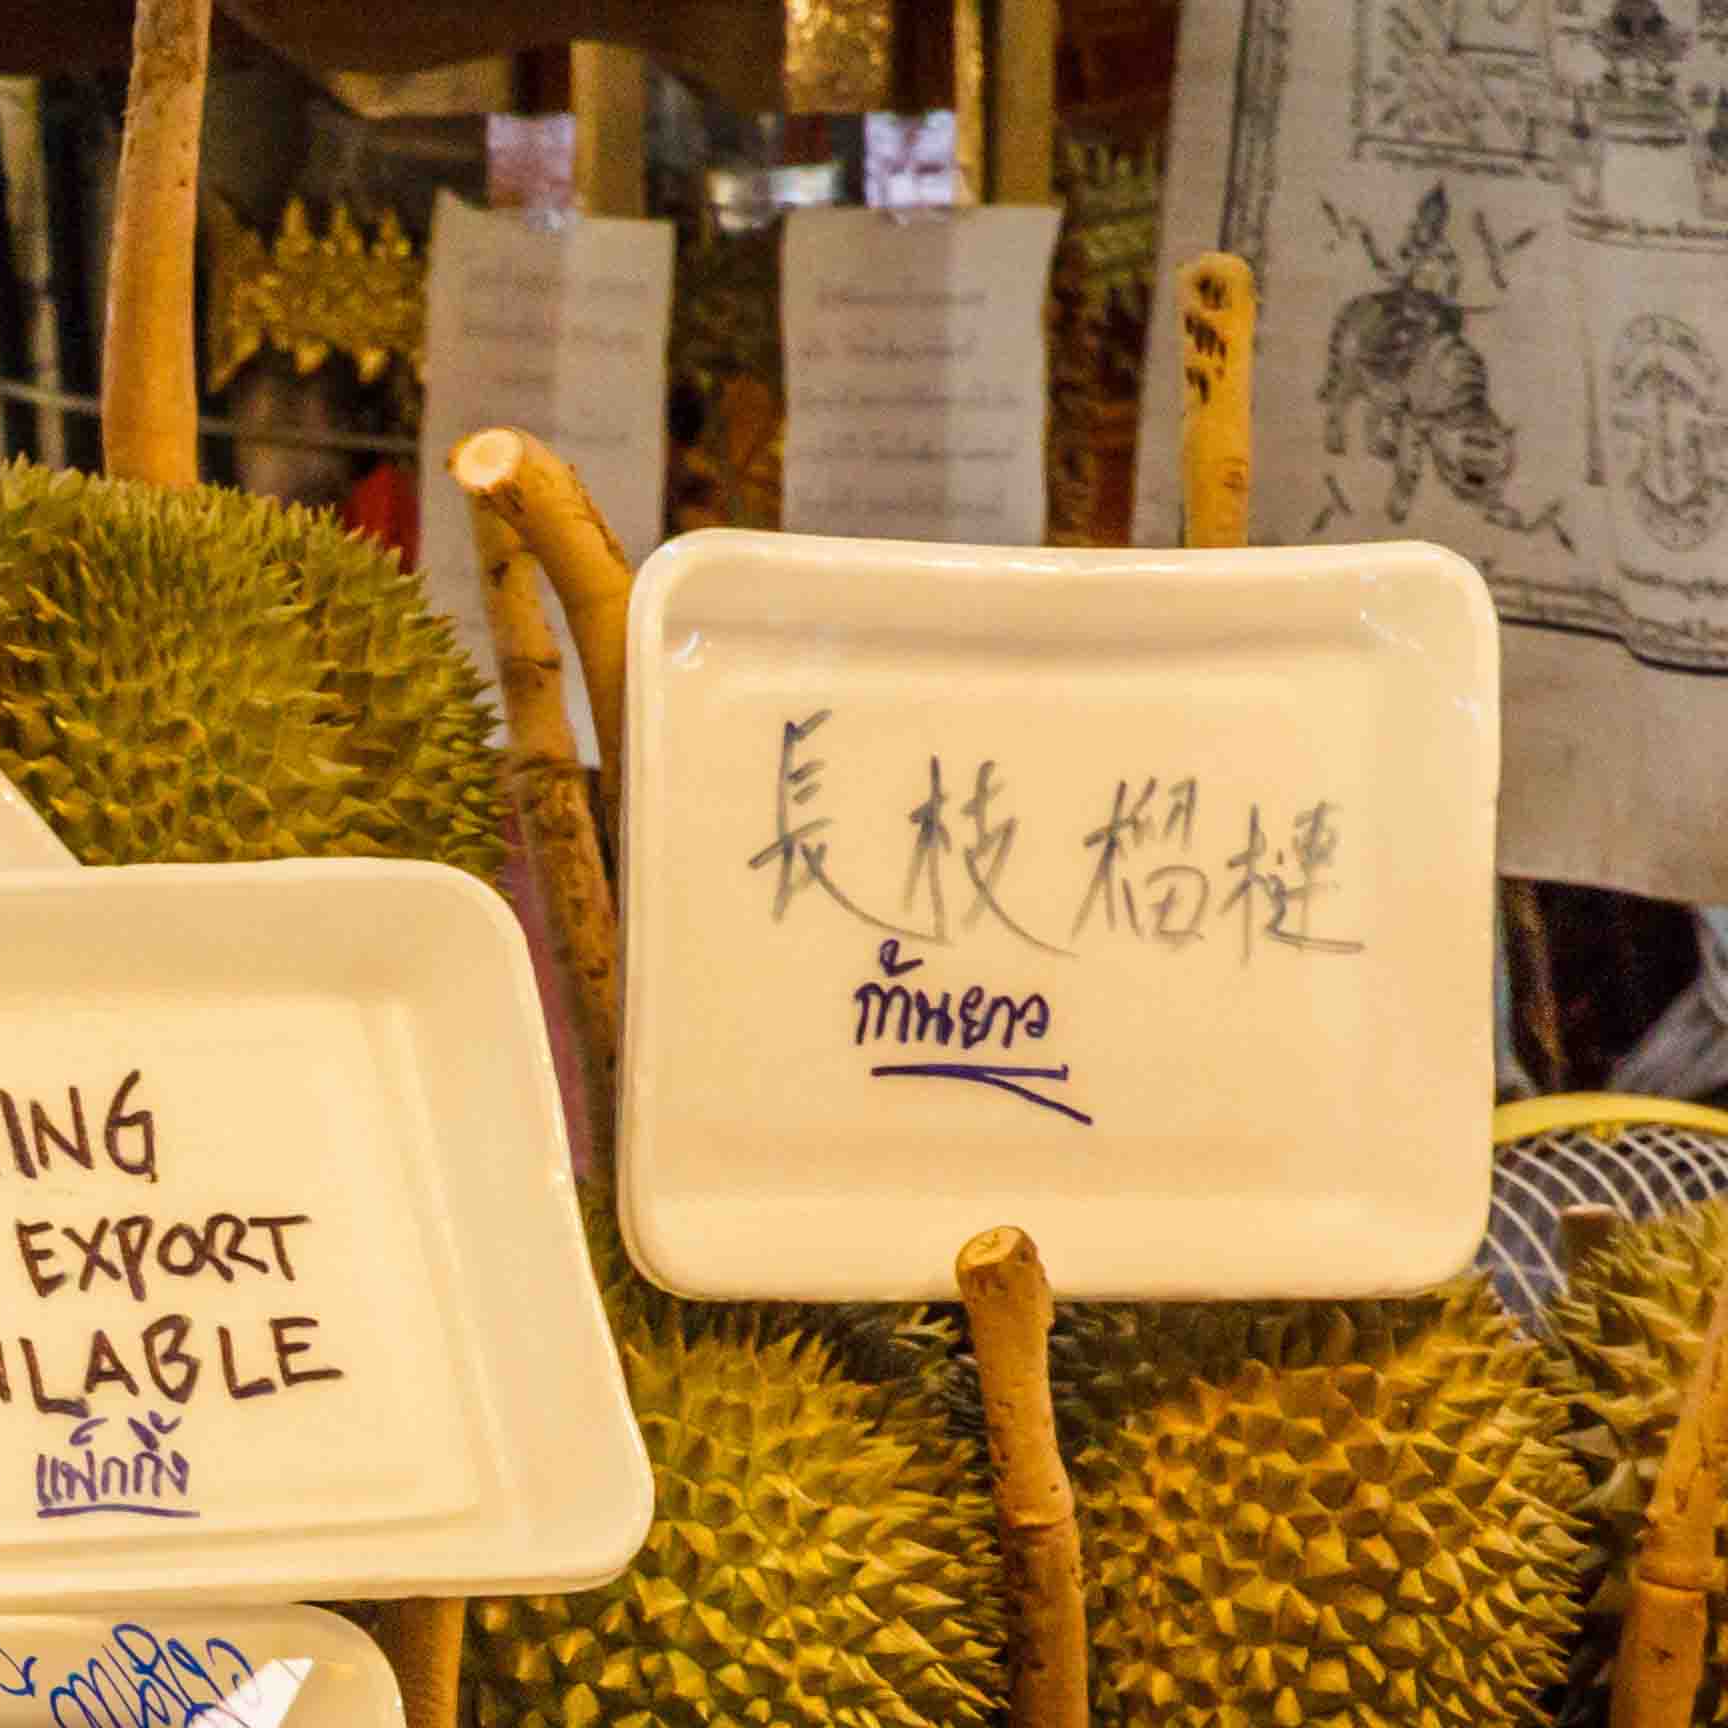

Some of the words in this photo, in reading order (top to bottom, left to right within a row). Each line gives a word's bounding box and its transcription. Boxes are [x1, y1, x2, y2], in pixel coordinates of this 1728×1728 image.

[853, 939, 1051, 1050] ก้านยาว
[15, 1213, 311, 1302] EXPORT
